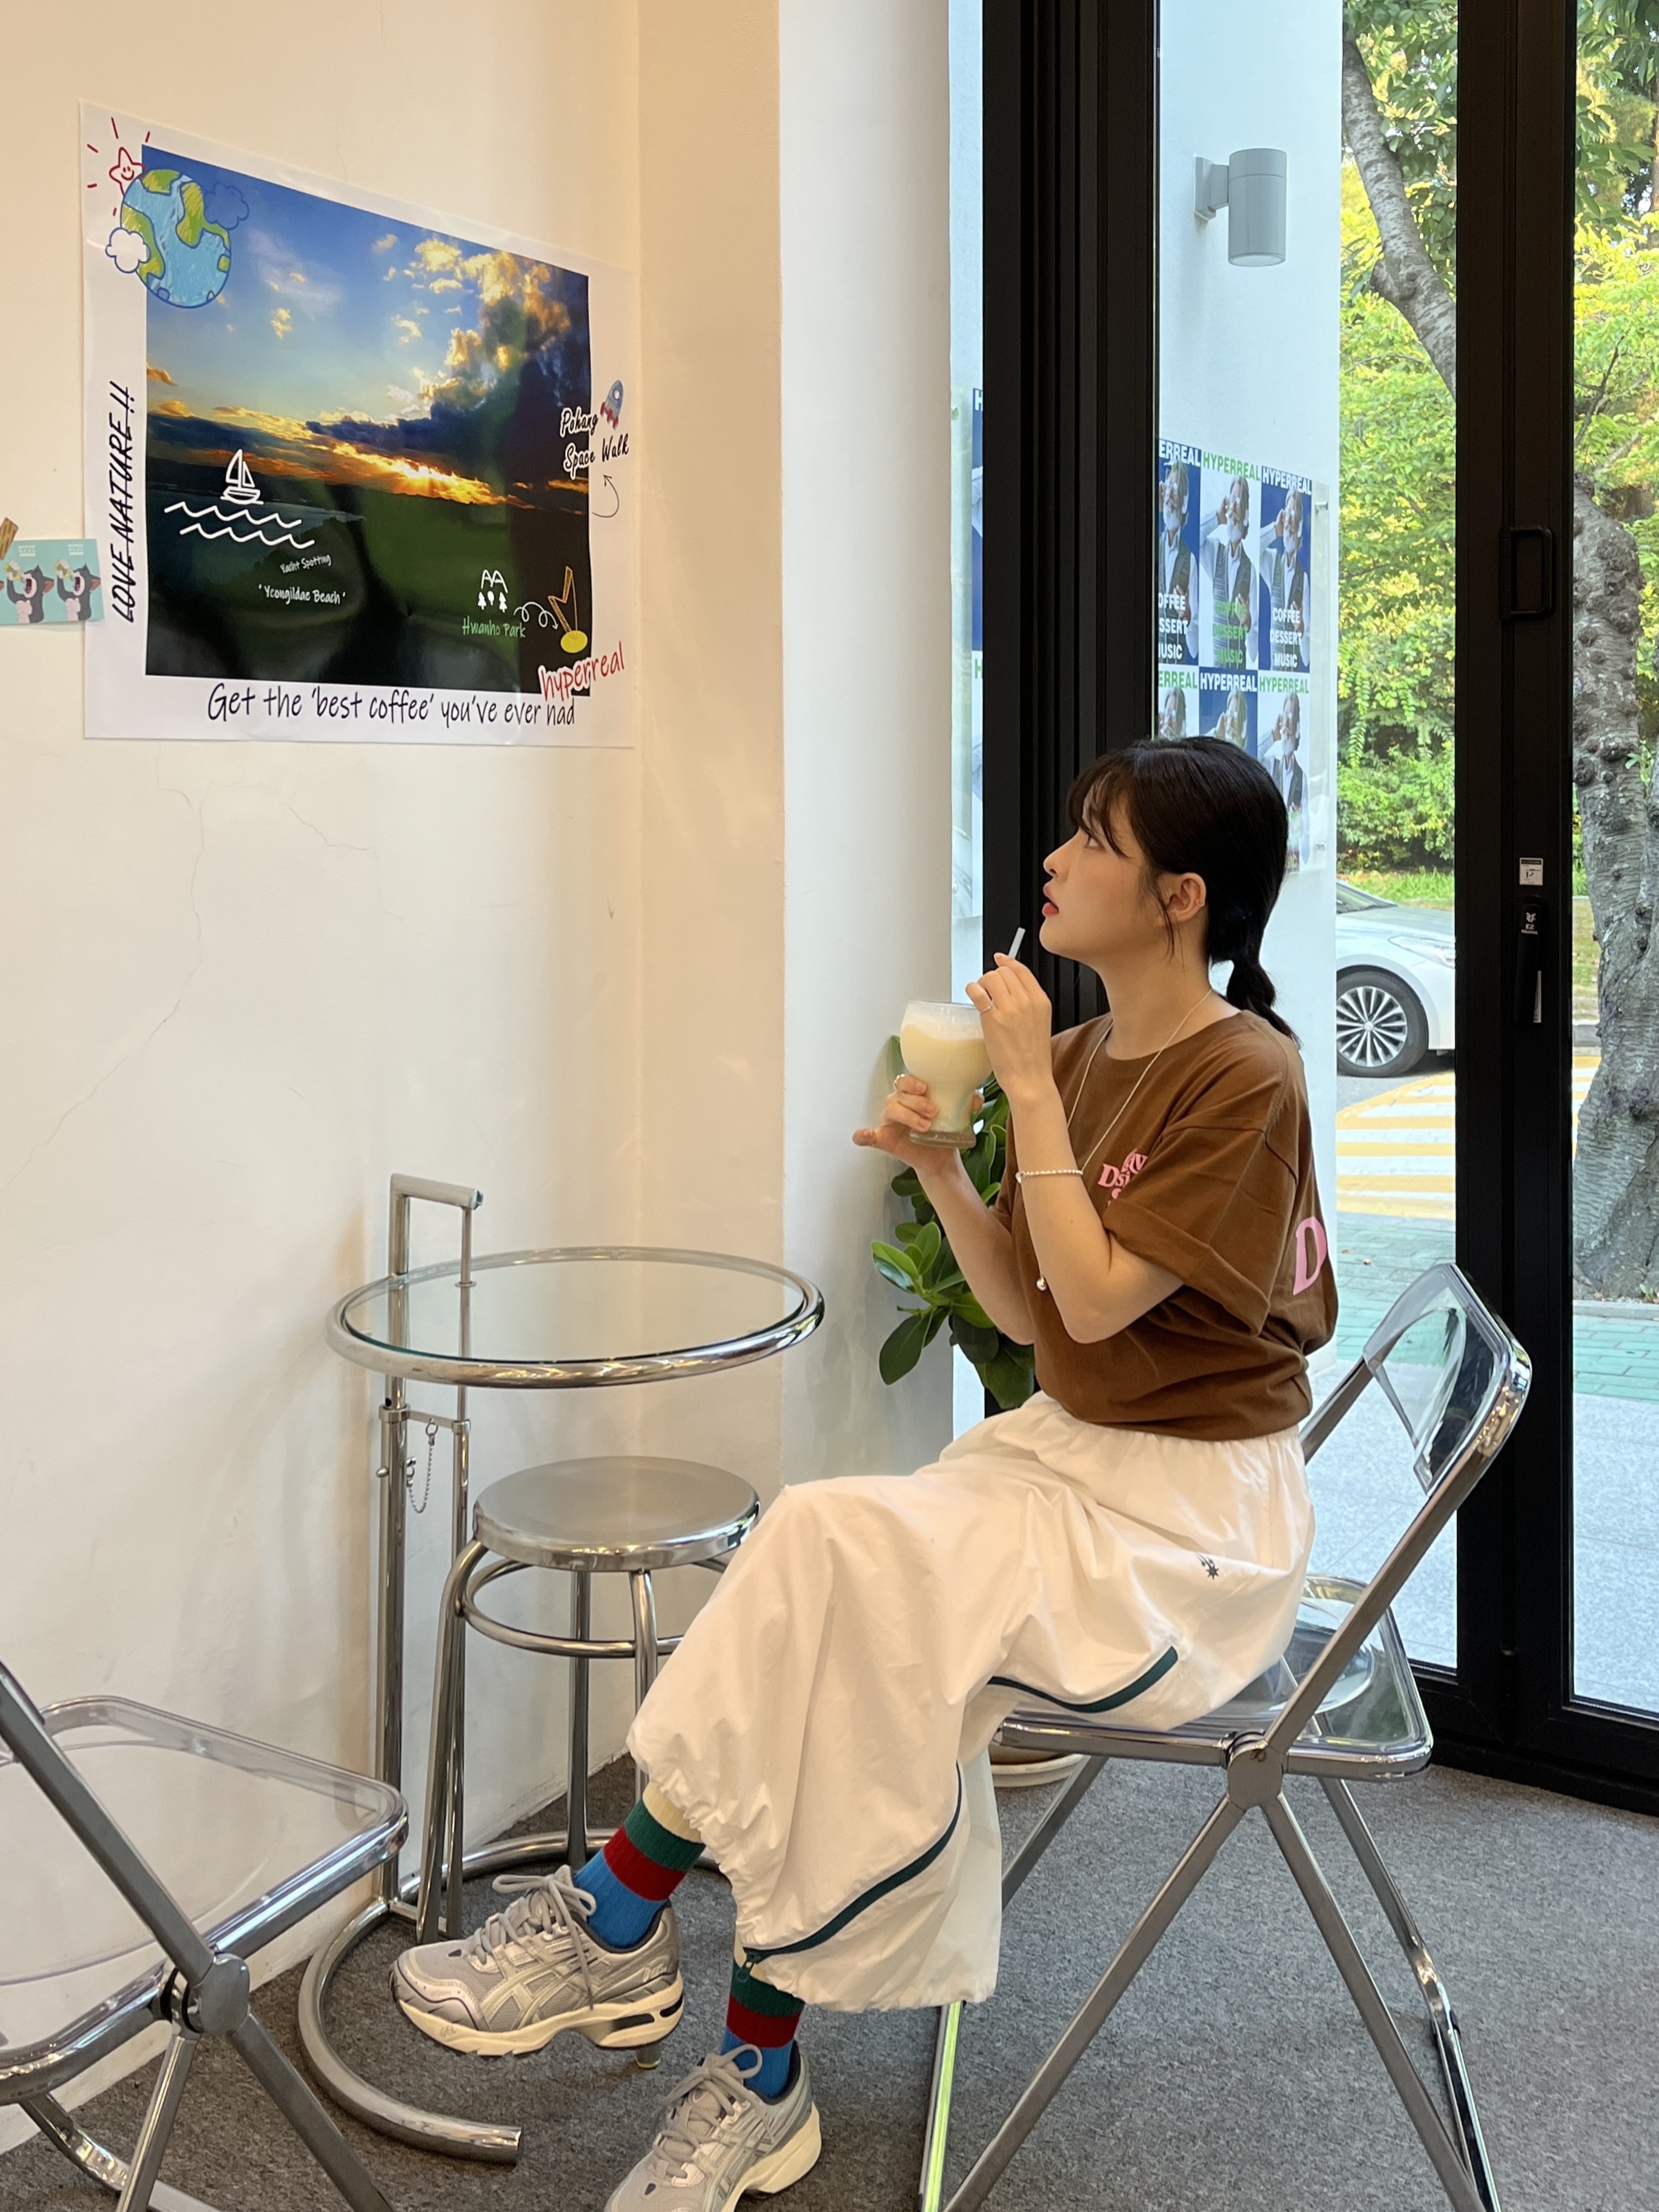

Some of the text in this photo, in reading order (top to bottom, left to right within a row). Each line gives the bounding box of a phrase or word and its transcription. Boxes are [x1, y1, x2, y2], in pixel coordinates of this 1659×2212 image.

[562, 408, 598, 436] Pohang
[565, 433, 629, 477] Space Walk
[1203, 451, 1260, 482] HYPERREAL
[108, 412, 134, 543] NATURE
[1262, 467, 1312, 495] HYPERREAL
[300, 554, 331, 570] Spotting
[111, 543, 136, 623] LOVE
[462, 615, 526, 638] Hwanho Park
[1273, 607, 1300, 623] COFFEE
[1270, 629, 1303, 645] DESSERT
[1217, 649, 1243, 664] MUSIC
[1274, 653, 1297, 668] MUSIC
[540, 640, 624, 701] hyperreal
[1199, 672, 1258, 692] HYPERREAL
[1259, 676, 1310, 694] HYPERREAL
[208, 682, 256, 722] Get
[263, 685, 302, 717] the
[311, 685, 362, 719] 'best
[369, 689, 434, 724] coffee'
[441, 695, 497, 728] you've
[504, 701, 541, 725] ever
